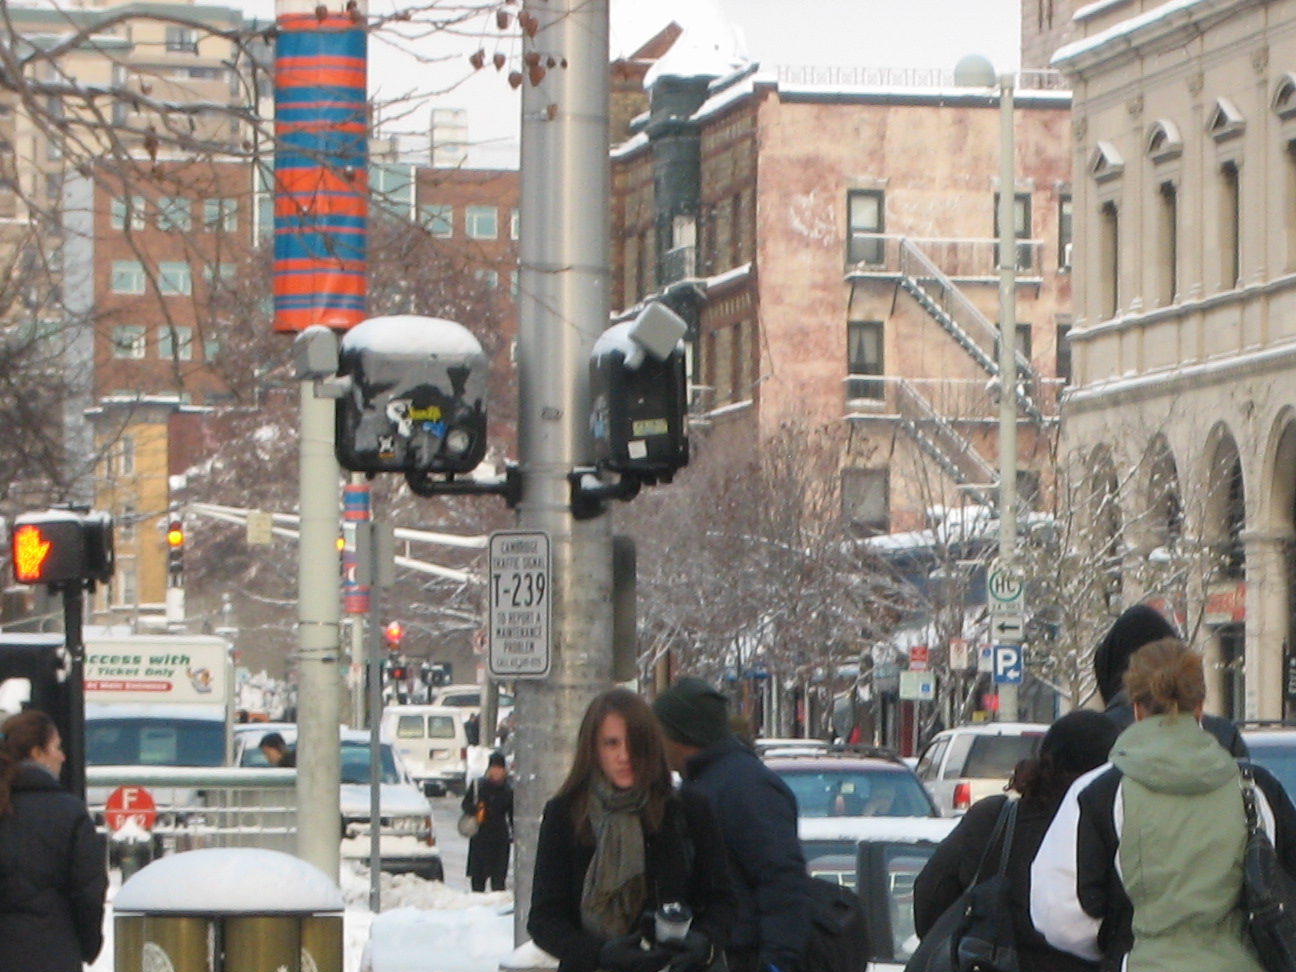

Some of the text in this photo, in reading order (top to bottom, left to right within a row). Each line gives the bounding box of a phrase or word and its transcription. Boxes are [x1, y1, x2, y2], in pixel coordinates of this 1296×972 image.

[493, 556, 545, 569] TRAFFIC SIGNAL
[493, 572, 546, 607] T-239
[508, 611, 534, 624] REPORT
[496, 626, 542, 639] MAINTENANCE
[503, 640, 535, 654] PROBLEM
[149, 653, 191, 665] with
[996, 649, 1018, 676] P
[98, 667, 175, 678] Ticket Only
[122, 787, 140, 811] F
